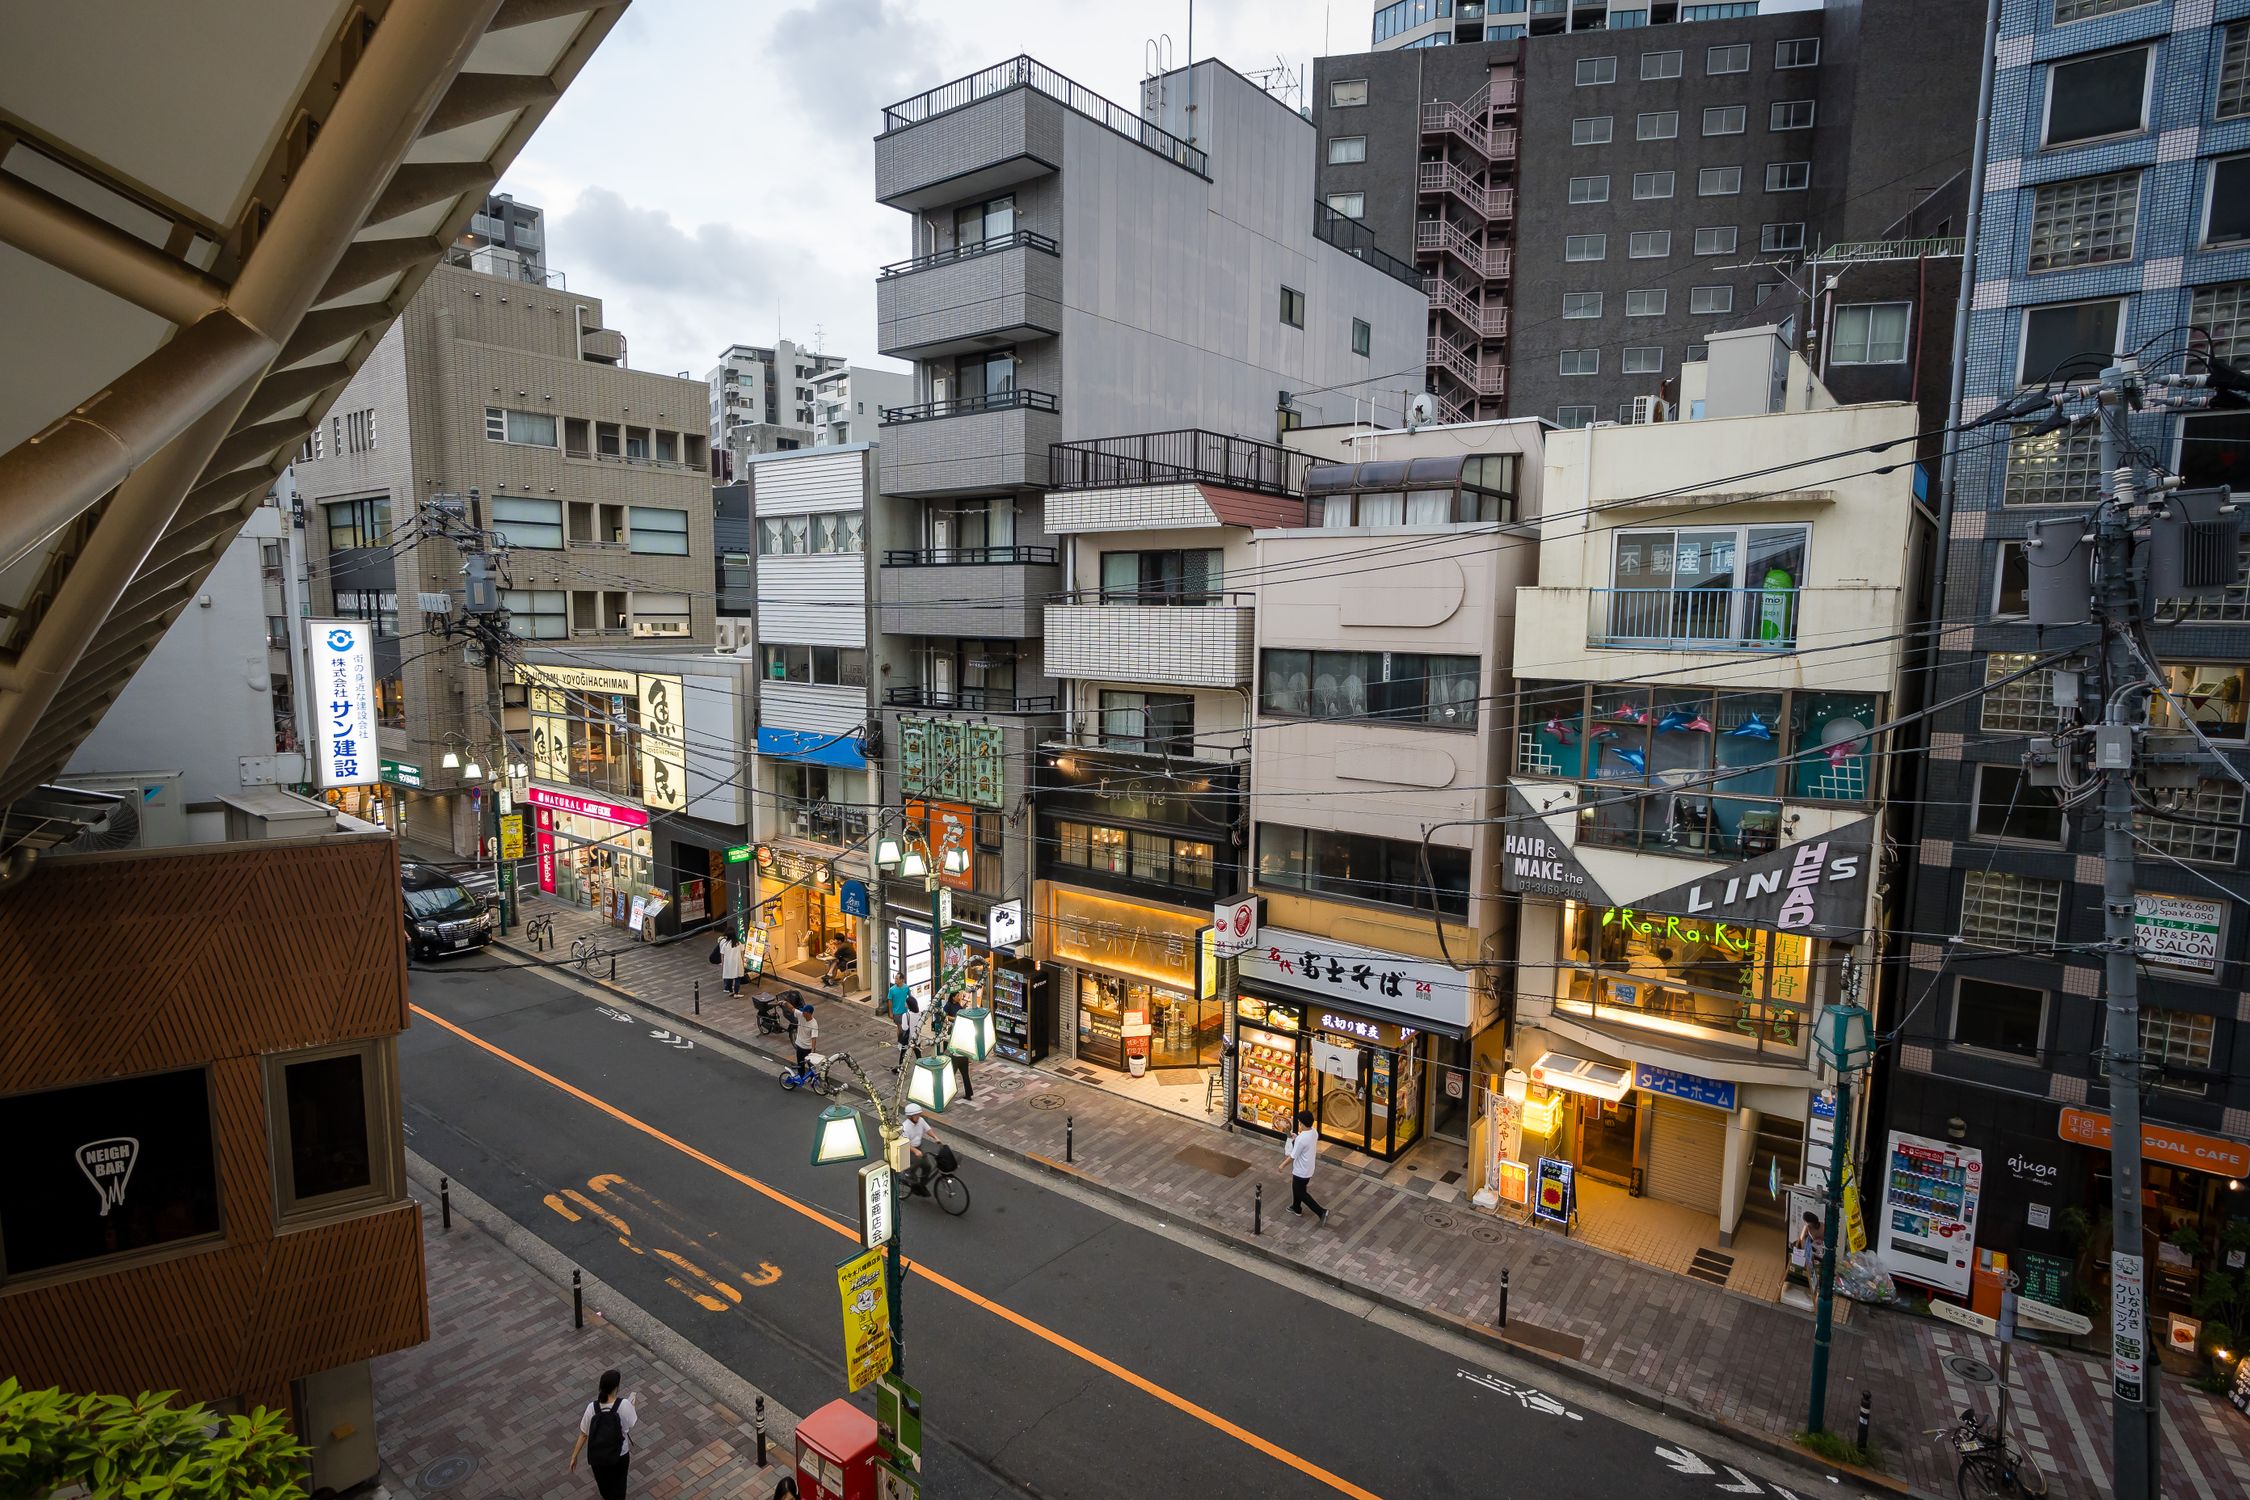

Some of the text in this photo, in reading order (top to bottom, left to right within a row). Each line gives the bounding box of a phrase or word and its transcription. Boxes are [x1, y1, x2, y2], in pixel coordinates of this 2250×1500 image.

[1619, 548, 1699, 574] 不動産
[337, 593, 360, 610] HIRAOKA
[379, 593, 399, 610] CLINIC
[563, 673, 629, 690] YOYOGIHACHIMAN
[330, 657, 359, 778] 株式会社サン建設
[544, 794, 581, 811] NATURAL
[1514, 857, 1584, 885] MAKE the
[1519, 880, 1589, 900] 03-3469-3434
[2159, 907, 2178, 917] Spa
[2160, 899, 2178, 909] Cut
[2155, 938, 2214, 957] SALON
[1268, 946, 1294, 975] 名代
[1299, 951, 1407, 998] 富士そば
[1415, 981, 1432, 993] 24
[1321, 1013, 1381, 1041] 乱切り蕎麦
[1640, 1073, 1729, 1106] タイユーホーム
[86, 1144, 130, 1165] NEIGH
[2144, 1136, 2241, 1166] GOAL CAFE
[95, 1160, 126, 1178] BAR
[2007, 1153, 2057, 1177] ajuga
[2115, 1283, 2128, 1332] クリニック
[2127, 1285, 2140, 1330] いながき
